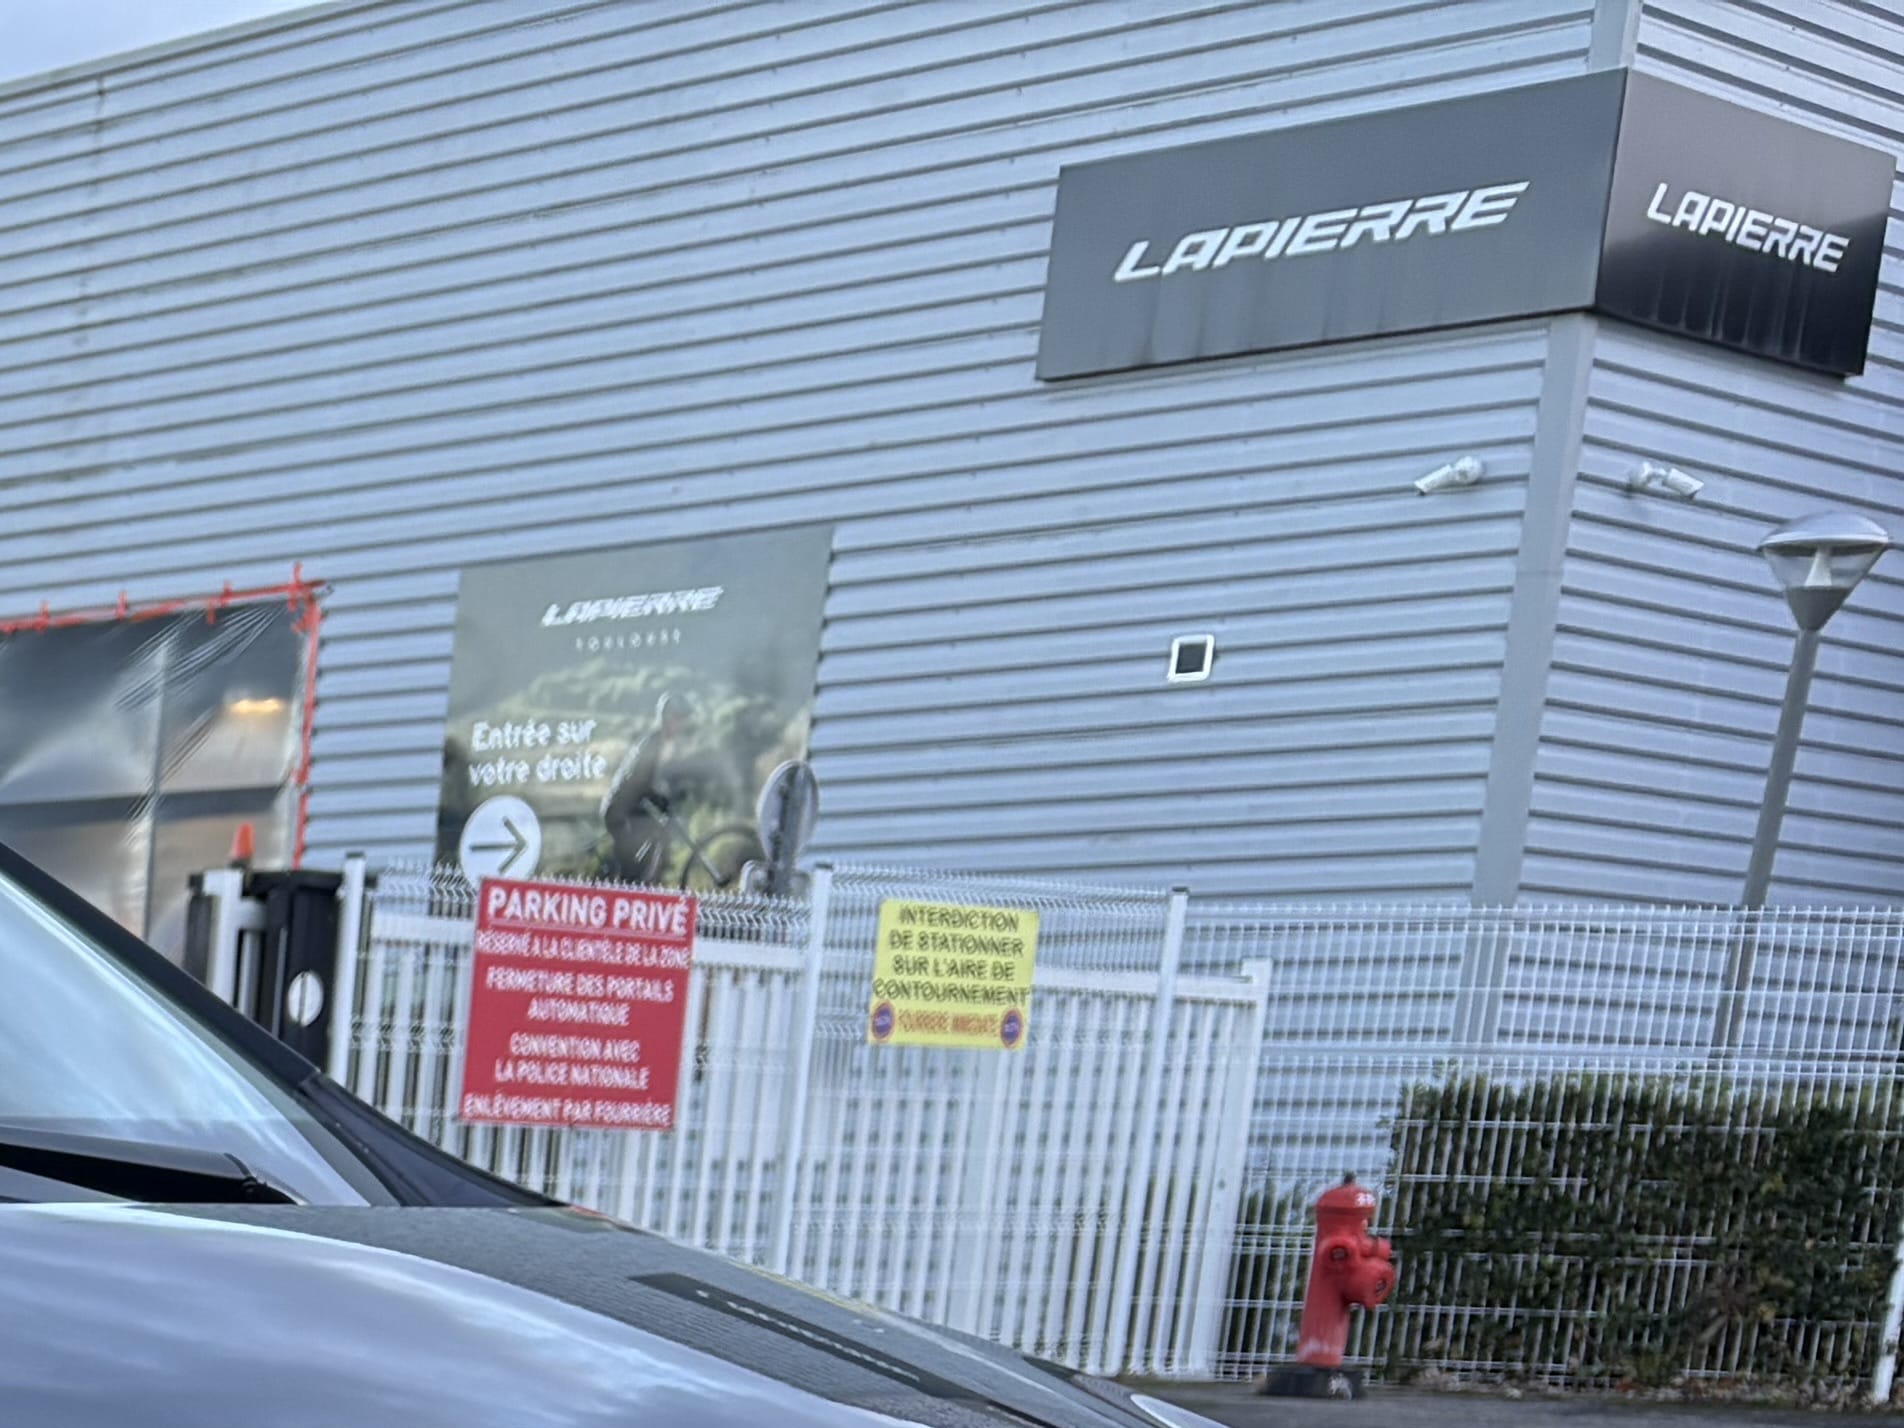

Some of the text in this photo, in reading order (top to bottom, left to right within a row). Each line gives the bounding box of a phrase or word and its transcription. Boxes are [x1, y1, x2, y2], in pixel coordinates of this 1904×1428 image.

[1112, 180, 1530, 285] LAPIERRE
[1645, 182, 1851, 274] LAPIERRE
[472, 718, 596, 751] Entrée sur
[469, 751, 608, 787] votre droite
[487, 887, 690, 937] PARKING PRIVÉ
[899, 905, 1020, 933] INTERDICTION
[889, 929, 1025, 958] DE STATIONNER
[893, 954, 930, 976] SUR
[992, 960, 1016, 982] DE
[872, 977, 1030, 1007] CONTOURNEMENT
[517, 1060, 569, 1086] POLICE
[571, 1065, 650, 1090] NATIONALE
